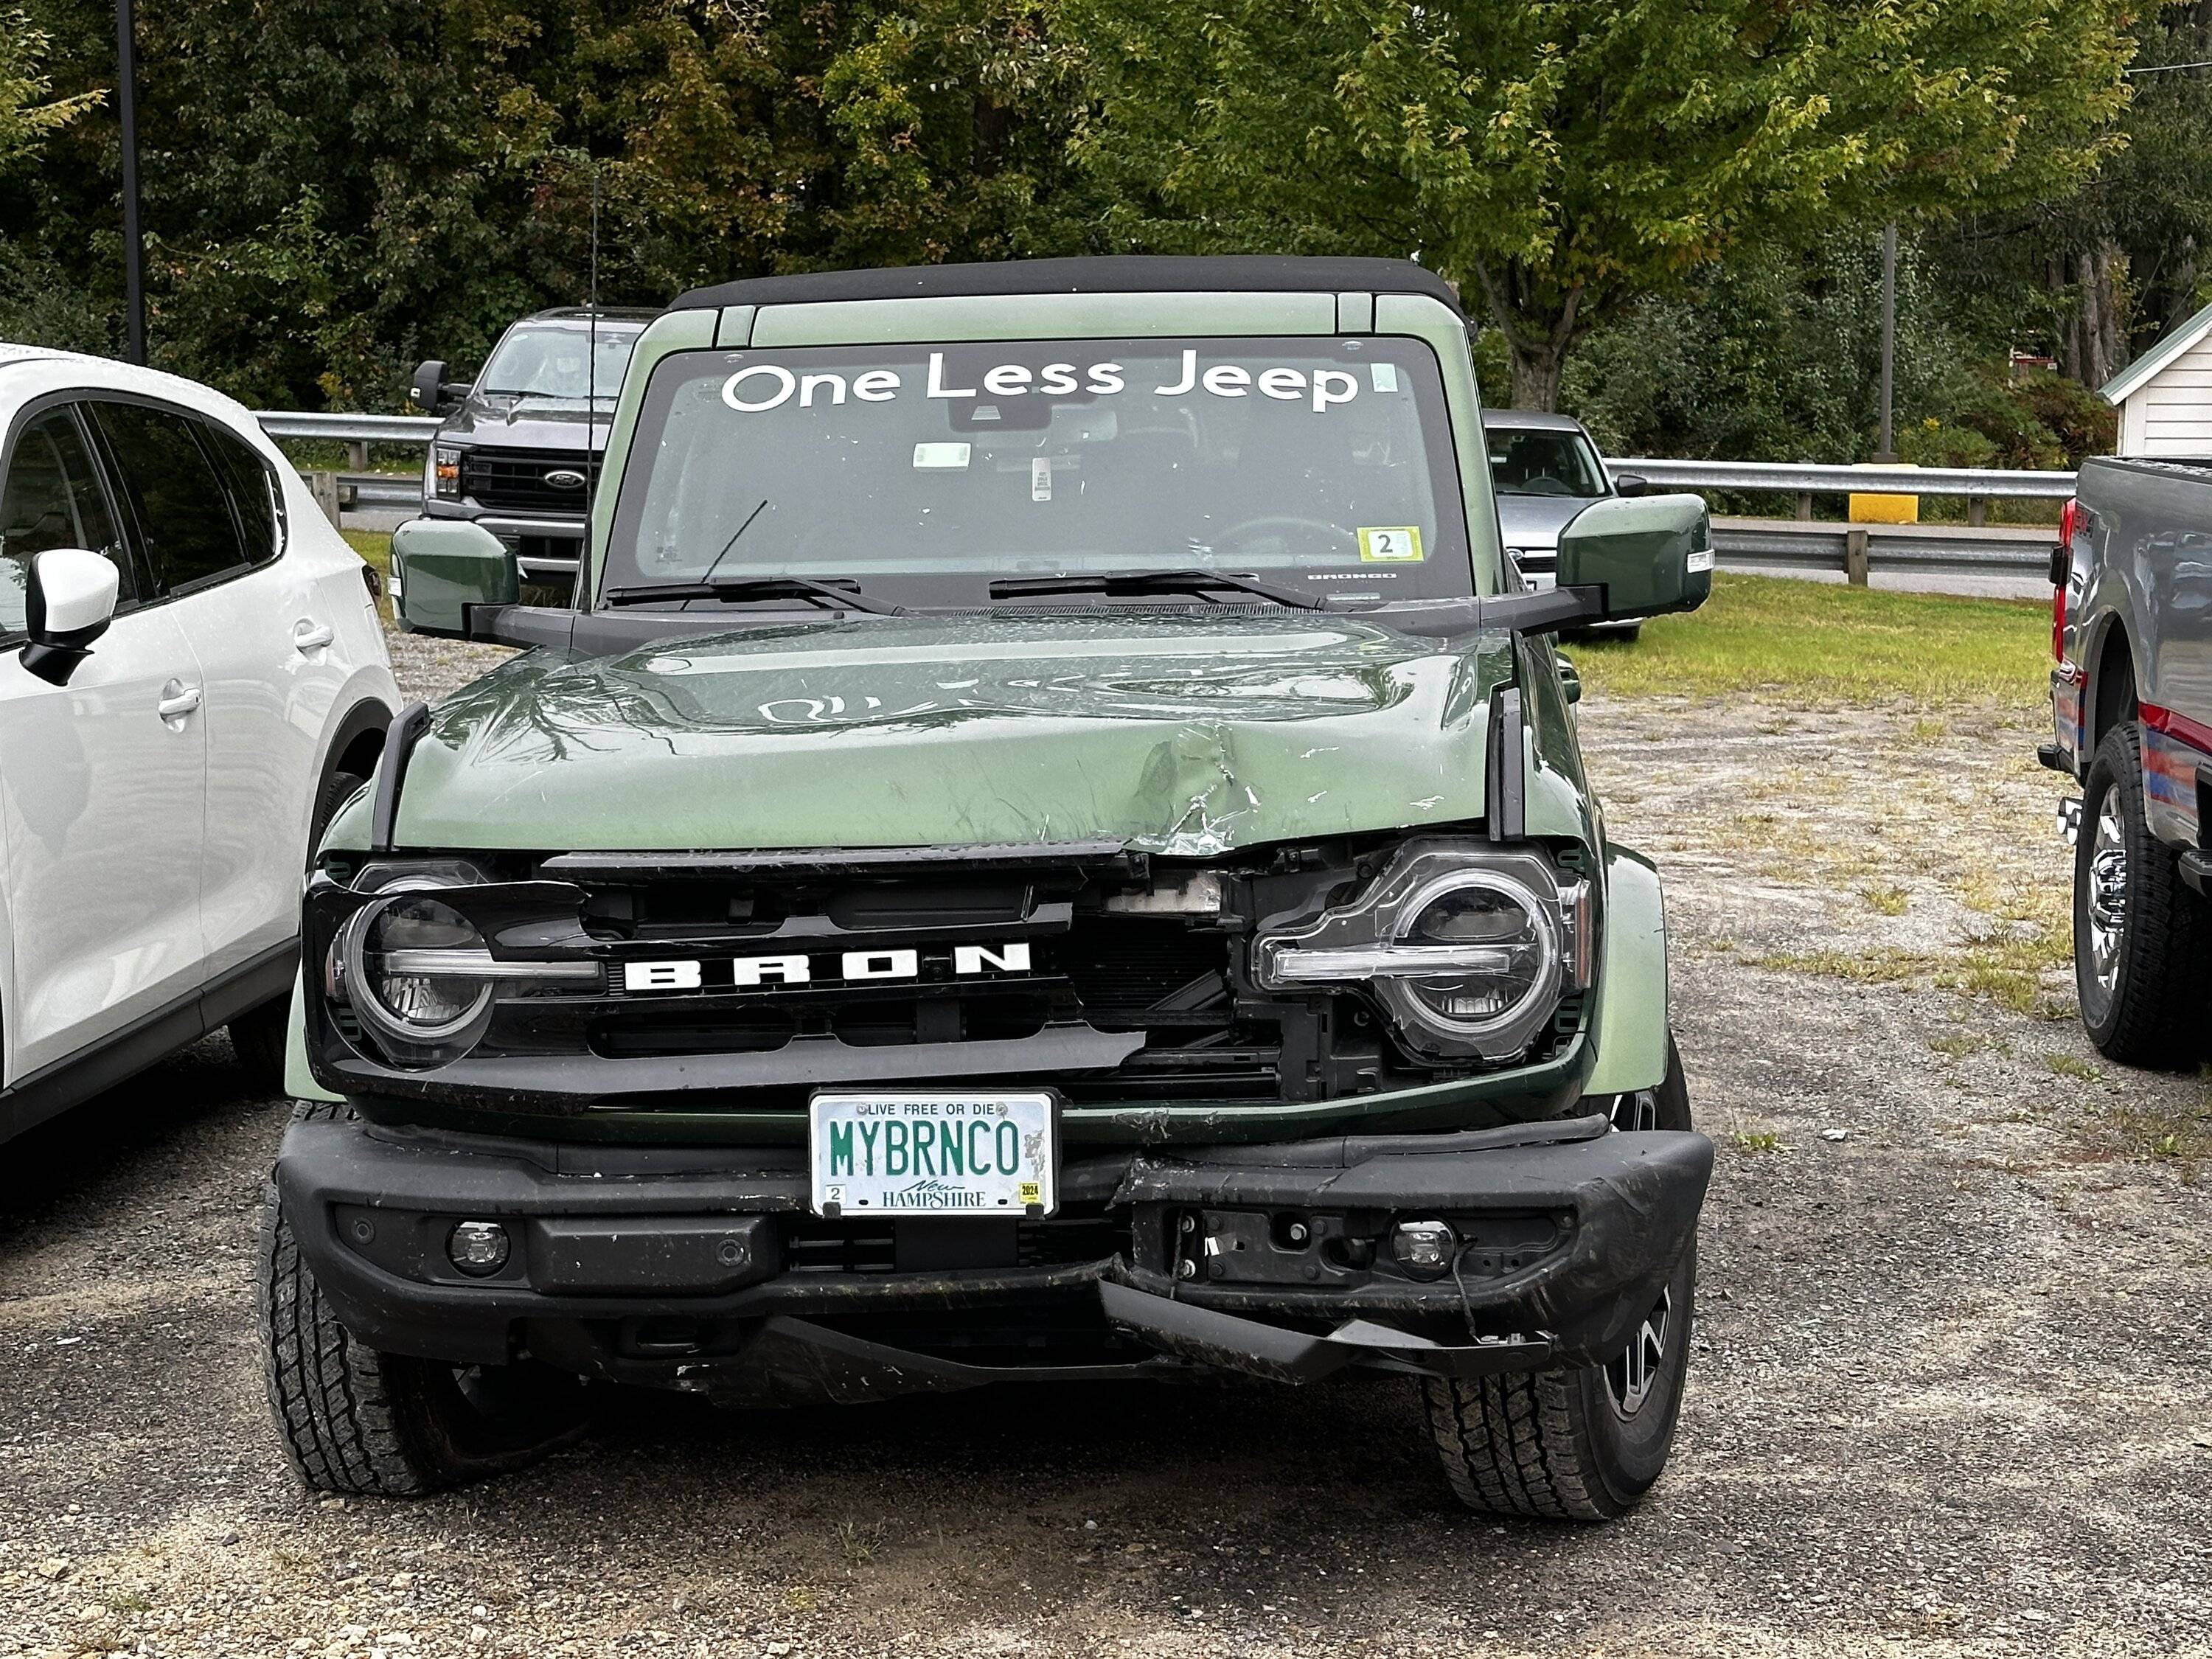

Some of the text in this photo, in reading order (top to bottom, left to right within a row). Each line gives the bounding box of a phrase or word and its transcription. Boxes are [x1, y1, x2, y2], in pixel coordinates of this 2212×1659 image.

[722, 349, 1359, 413] One Less Jeep
[1378, 534, 1394, 553] 2
[868, 1103, 995, 1116] LIVE FREE OR DIE
[830, 1119, 1020, 1177] MYBRNCO
[830, 1187, 841, 1200] 2
[901, 1180, 965, 1193] New
[1022, 1185, 1039, 1195] 2024
[883, 1191, 987, 1209] HAMPSHIRE
